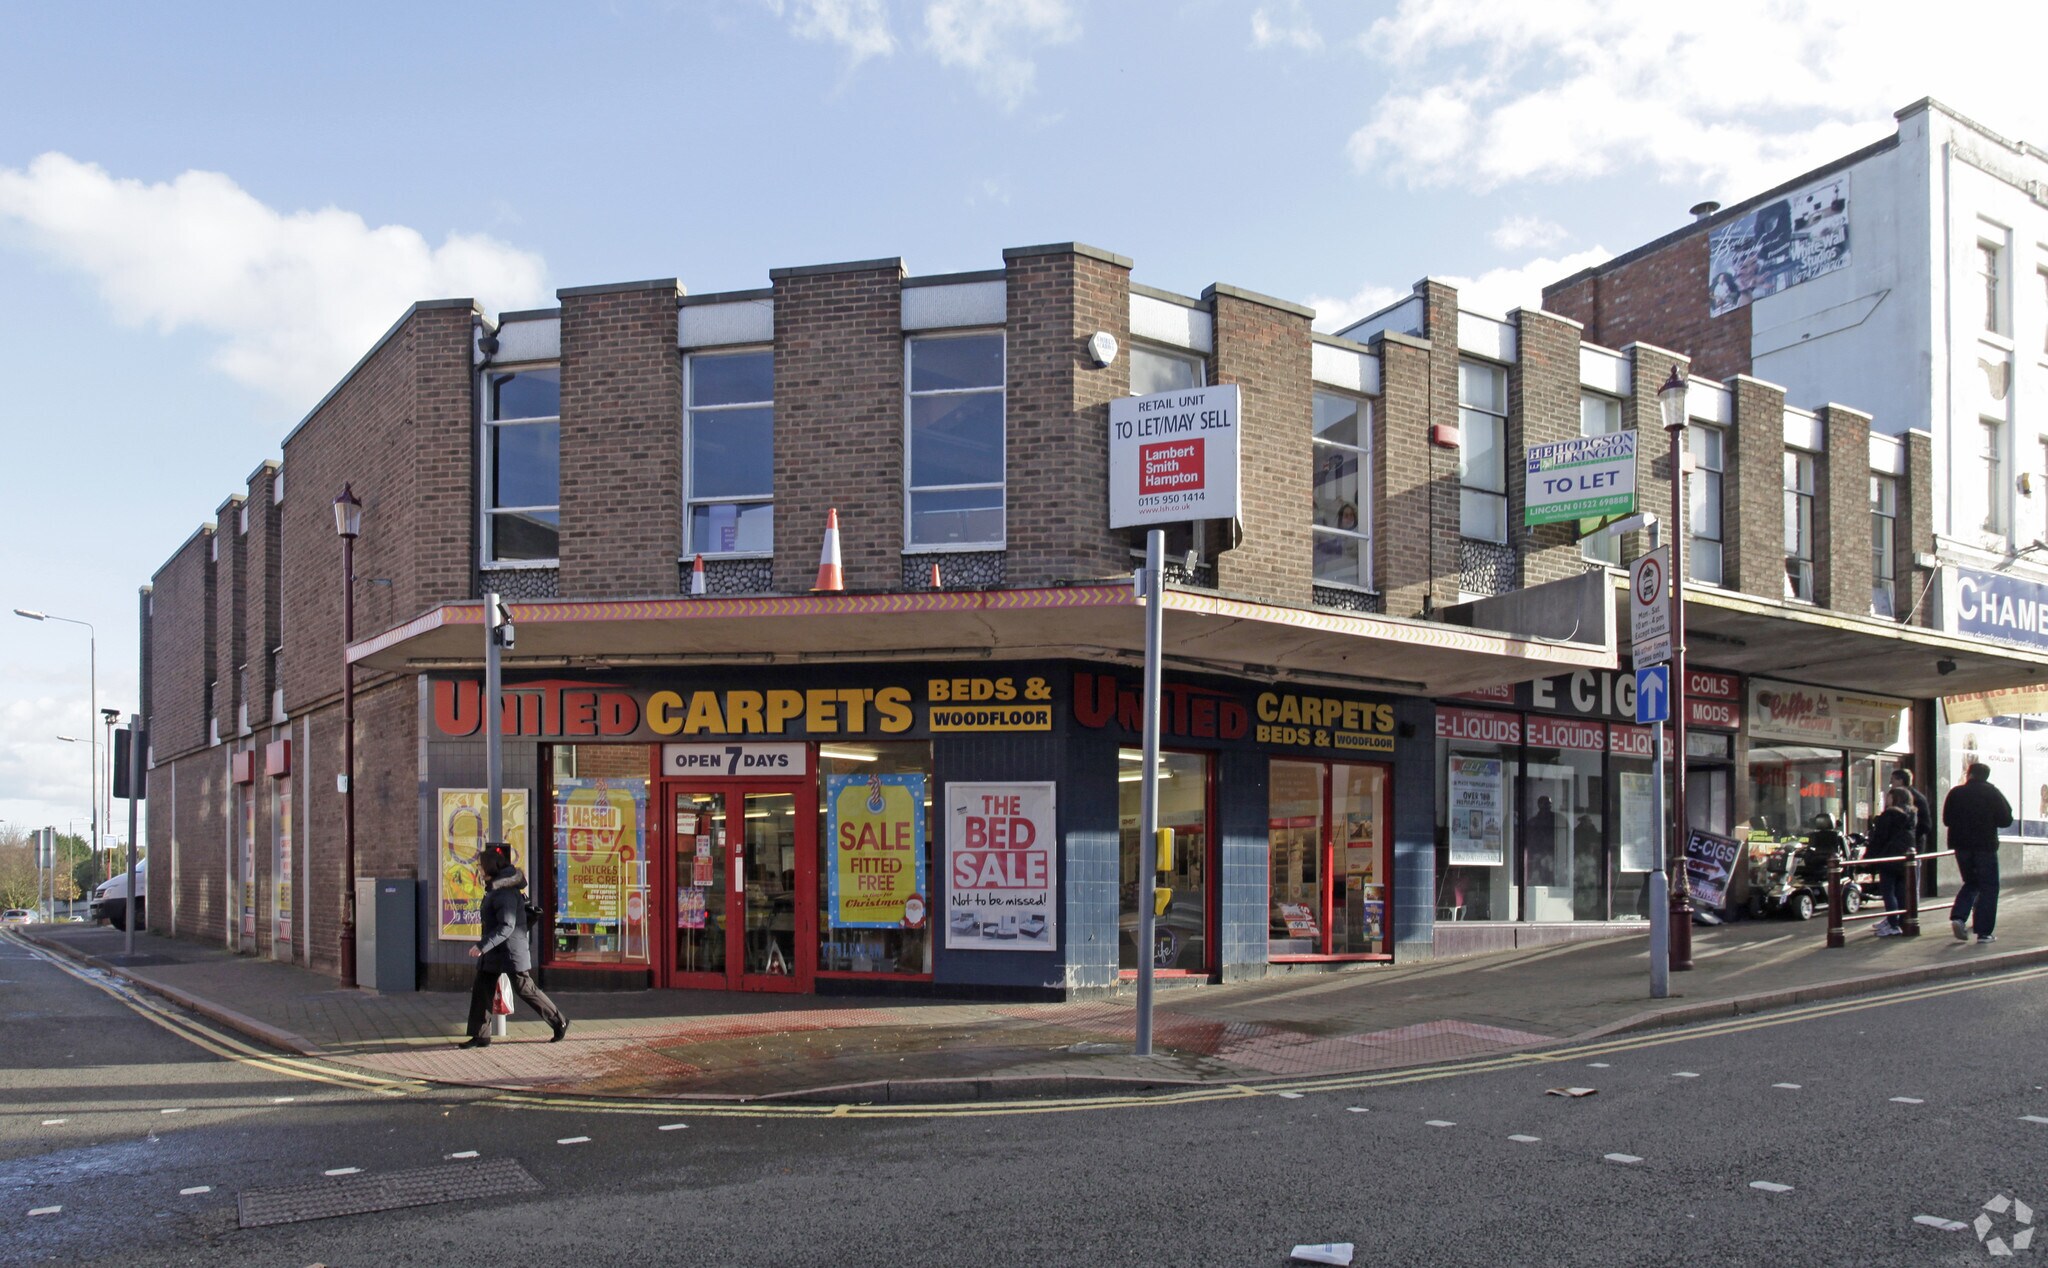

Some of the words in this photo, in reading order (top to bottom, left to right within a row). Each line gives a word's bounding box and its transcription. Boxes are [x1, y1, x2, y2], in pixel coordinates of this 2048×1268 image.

[1139, 398, 1174, 412] RETAIL
[1179, 394, 1205, 407] UNIT
[1116, 422, 1132, 440] TO
[1138, 412, 1196, 438] LET/MAY
[1200, 410, 1231, 430] SELL
[1556, 435, 1632, 453] HODGSON
[1146, 445, 1195, 462] Lambert
[1555, 444, 1633, 464] ELKINGTON
[1146, 460, 1179, 474] Smith
[1146, 472, 1198, 487] Hampton
[1543, 478, 1572, 494] TO
[1580, 470, 1620, 490] LET
[1138, 496, 1160, 506] 0115
[1162, 494, 1180, 504] 950
[1183, 492, 1205, 502] 1414
[1530, 504, 1571, 516] LINCOLN
[1573, 500, 1596, 510] 01522
[1138, 503, 1191, 514] www.lsh.co.uk
[1652, 606, 1660, 614] Sat
[1634, 630, 1650, 640] Except
[1641, 645, 1652, 653] other
[1654, 640, 1668, 650] times
[1653, 650, 1664, 659] only
[1692, 675, 1729, 695] COILS
[434, 679, 640, 736] UNITED
[646, 687, 912, 734] CARPETS
[928, 678, 1017, 702] BEDS
[1025, 677, 1052, 700] &
[1074, 673, 1248, 739] UNITED
[1257, 692, 1394, 732] CARPETS
[1693, 704, 1729, 722] MODS
[1770, 691, 1814, 725] Coffee
[934, 710, 1048, 726] WOODFLOOR
[1798, 715, 1832, 732] CROWN
[1256, 724, 1310, 746] BEDS
[1314, 730, 1330, 747] &
[1337, 734, 1392, 748] WOODFLOOR
[1436, 714, 1520, 742] E-LIQUIDS
[1527, 724, 1604, 749] E-LIQUIDS
[1610, 731, 1674, 755] E-LIQUD
[676, 754, 722, 767] OPEN
[726, 746, 743, 775] 7
[744, 754, 790, 767] DAYS
[982, 795, 1020, 816] THE
[840, 822, 910, 851] SALE
[966, 817, 1036, 849] BED
[570, 825, 635, 864] 0%
[1688, 835, 1736, 862] E-CIGS
[850, 858, 902, 874] FITTED
[956, 854, 1047, 887] SALE
[574, 875, 593, 884] FREE
[596, 875, 631, 885] CREDIT
[858, 875, 895, 891] FREE
[846, 898, 905, 908] Christmas
[952, 892, 972, 906] Not
[975, 896, 986, 906] to
[989, 892, 1004, 906] be
[1006, 892, 1047, 906] missed!
[1154, 938, 1174, 963] ife!
